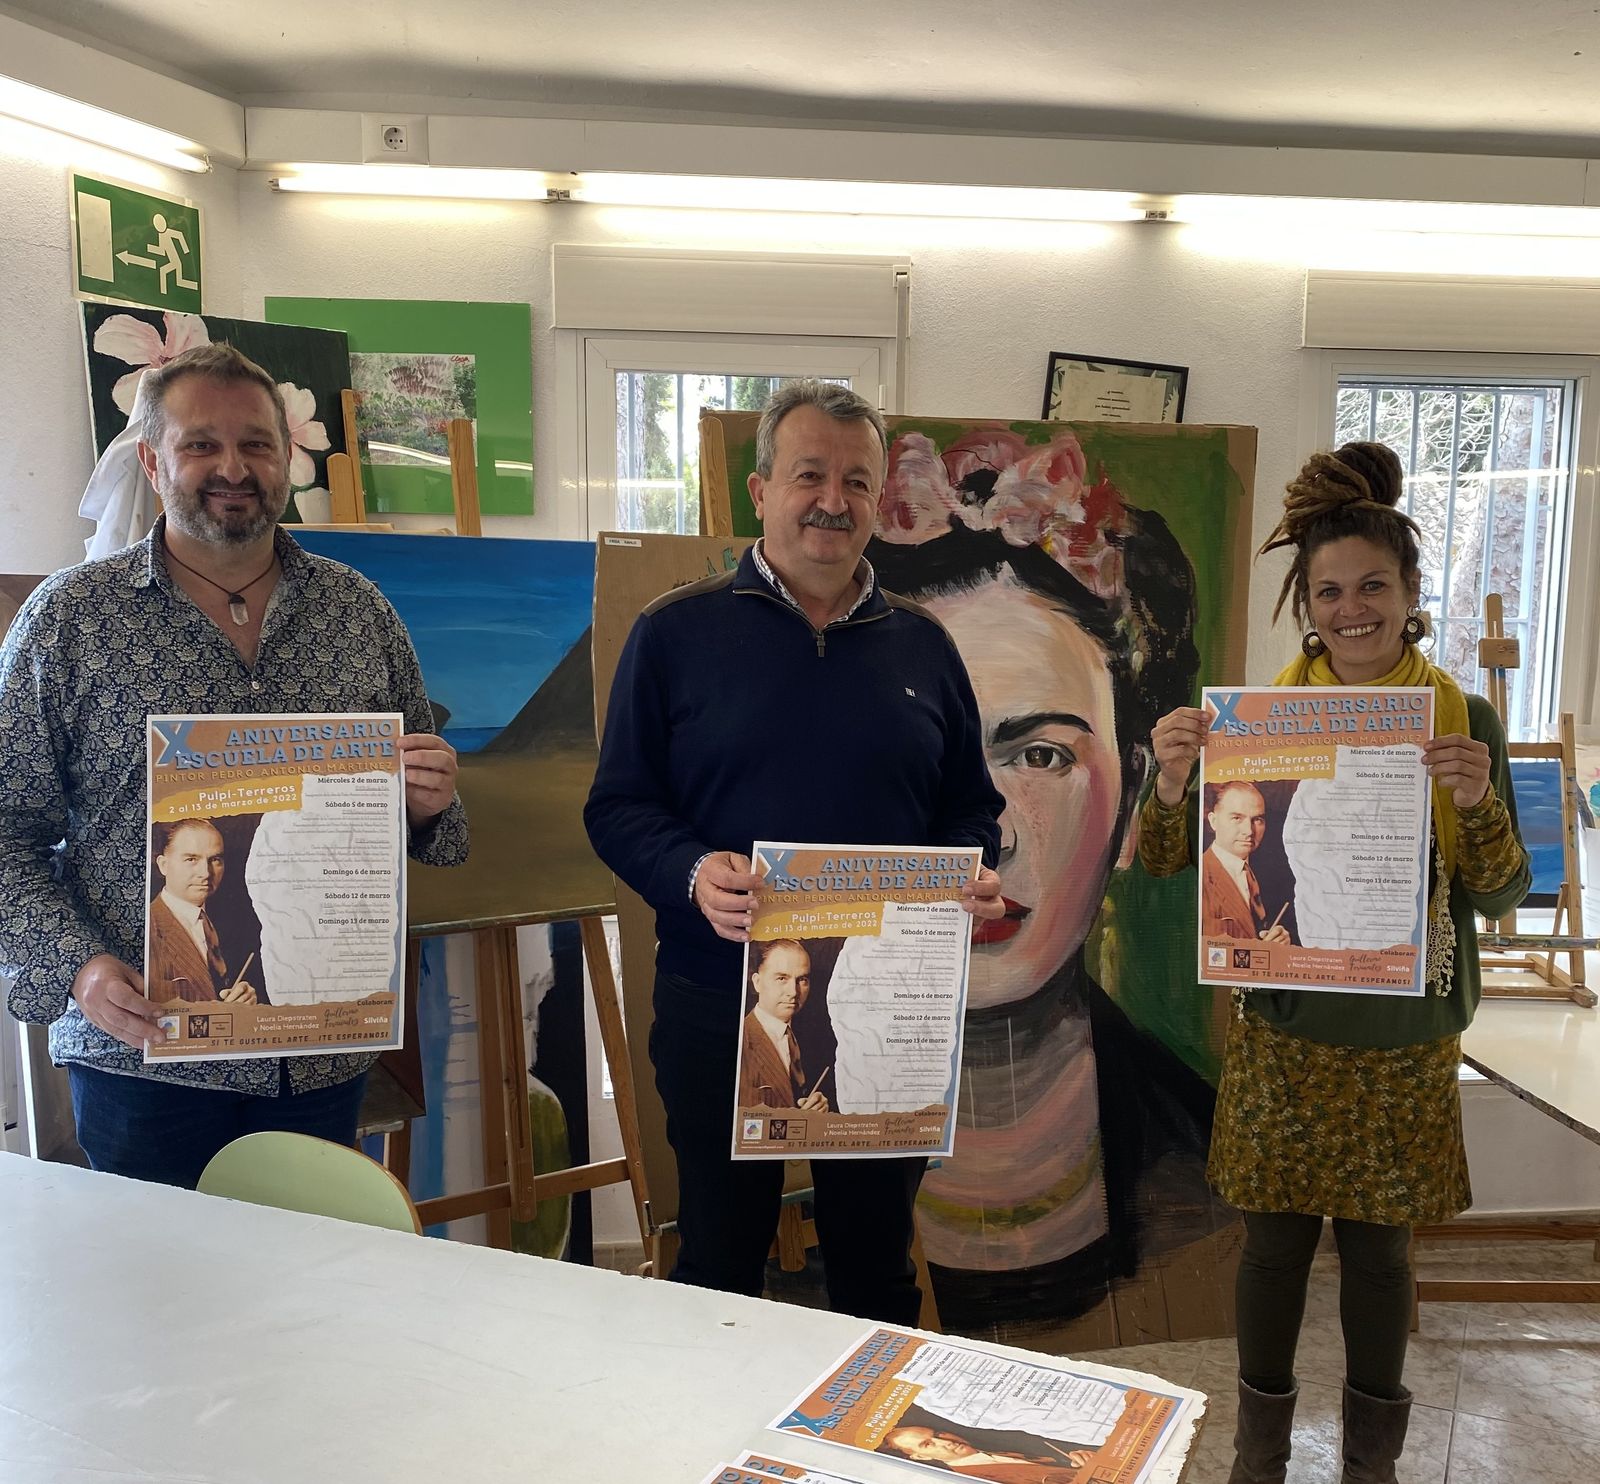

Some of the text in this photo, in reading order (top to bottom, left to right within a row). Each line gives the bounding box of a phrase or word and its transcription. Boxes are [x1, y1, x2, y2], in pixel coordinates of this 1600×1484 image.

[1268, 694, 1425, 717] ANIVERSARIO
[225, 720, 394, 747] ANIVERSARIO
[1225, 713, 1425, 737] ESCUELA DE ARTE
[175, 738, 395, 770] ESCUELA DE ARTE
[155, 772, 207, 784] PINTOR
[211, 768, 254, 780] PEDRO
[261, 764, 321, 777] ANTONIO
[179, 805, 188, 813] al
[206, 802, 217, 810] de
[222, 799, 253, 808] marzo
[273, 793, 297, 803] 2022
[821, 854, 973, 873] ANIVERSARIO
[774, 873, 968, 892] ESCUELA DE ARTE
[842, 921, 853, 929] de
[856, 920, 877, 928] 2022
[821, 1331, 891, 1403] ANIVERSARIO
[819, 1378, 874, 1429] ESCUELA
[863, 1364, 887, 1378] DE
